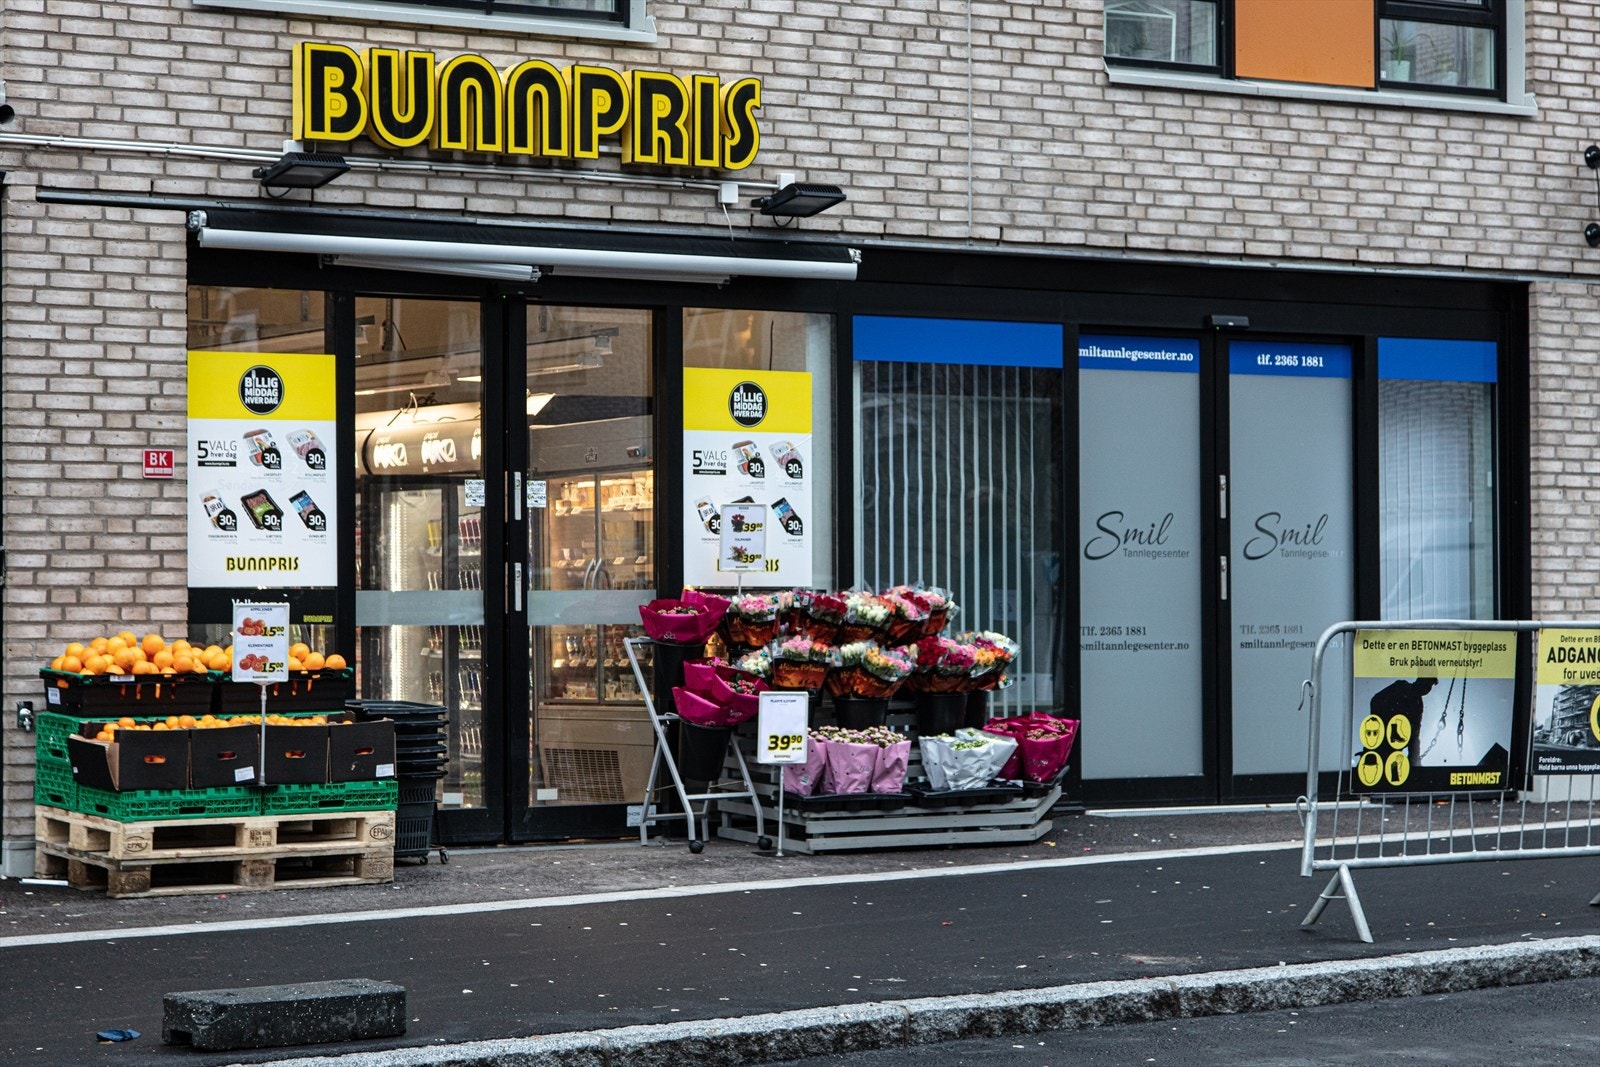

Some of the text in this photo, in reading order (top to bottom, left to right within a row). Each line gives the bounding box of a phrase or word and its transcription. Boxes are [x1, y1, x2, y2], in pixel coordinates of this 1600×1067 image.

[292, 42, 761, 170] BUNNPRIS
[1257, 353, 1324, 368] tlf. 2365 1881
[244, 376, 279, 388] BILLIG
[244, 388, 279, 397] MIDDAG
[733, 391, 763, 402] BILLIG
[244, 396, 279, 405] HVER DAG
[733, 402, 763, 411] MIDDAG
[733, 410, 763, 418] HVER DAG
[197, 440, 237, 459] 5 VALG
[225, 451, 237, 459] dag
[149, 452, 168, 466] BK
[692, 450, 727, 468] 5 VALG
[717, 460, 727, 468] dag
[1084, 511, 1174, 560] Smil
[1243, 511, 1329, 561] Smil
[1123, 548, 1190, 560] Tannlegesenter
[225, 556, 299, 572] BUNNPRIS
[1080, 626, 1147, 636] Tlf. 2365 1881
[1258, 625, 1280, 635] 2365
[1283, 625, 1303, 635] 1881
[1240, 639, 1316, 651] smiltannlegesen
[1560, 635, 1576, 643] Dette
[1362, 639, 1507, 653] Dette er en BETONMAST byggeplass
[1546, 646, 1600, 664] ADGAN
[1389, 656, 1483, 669] Bruk påbudt verneutstyr!
[1563, 667, 1577, 680] for
[1450, 771, 1501, 785] BETONMAST
